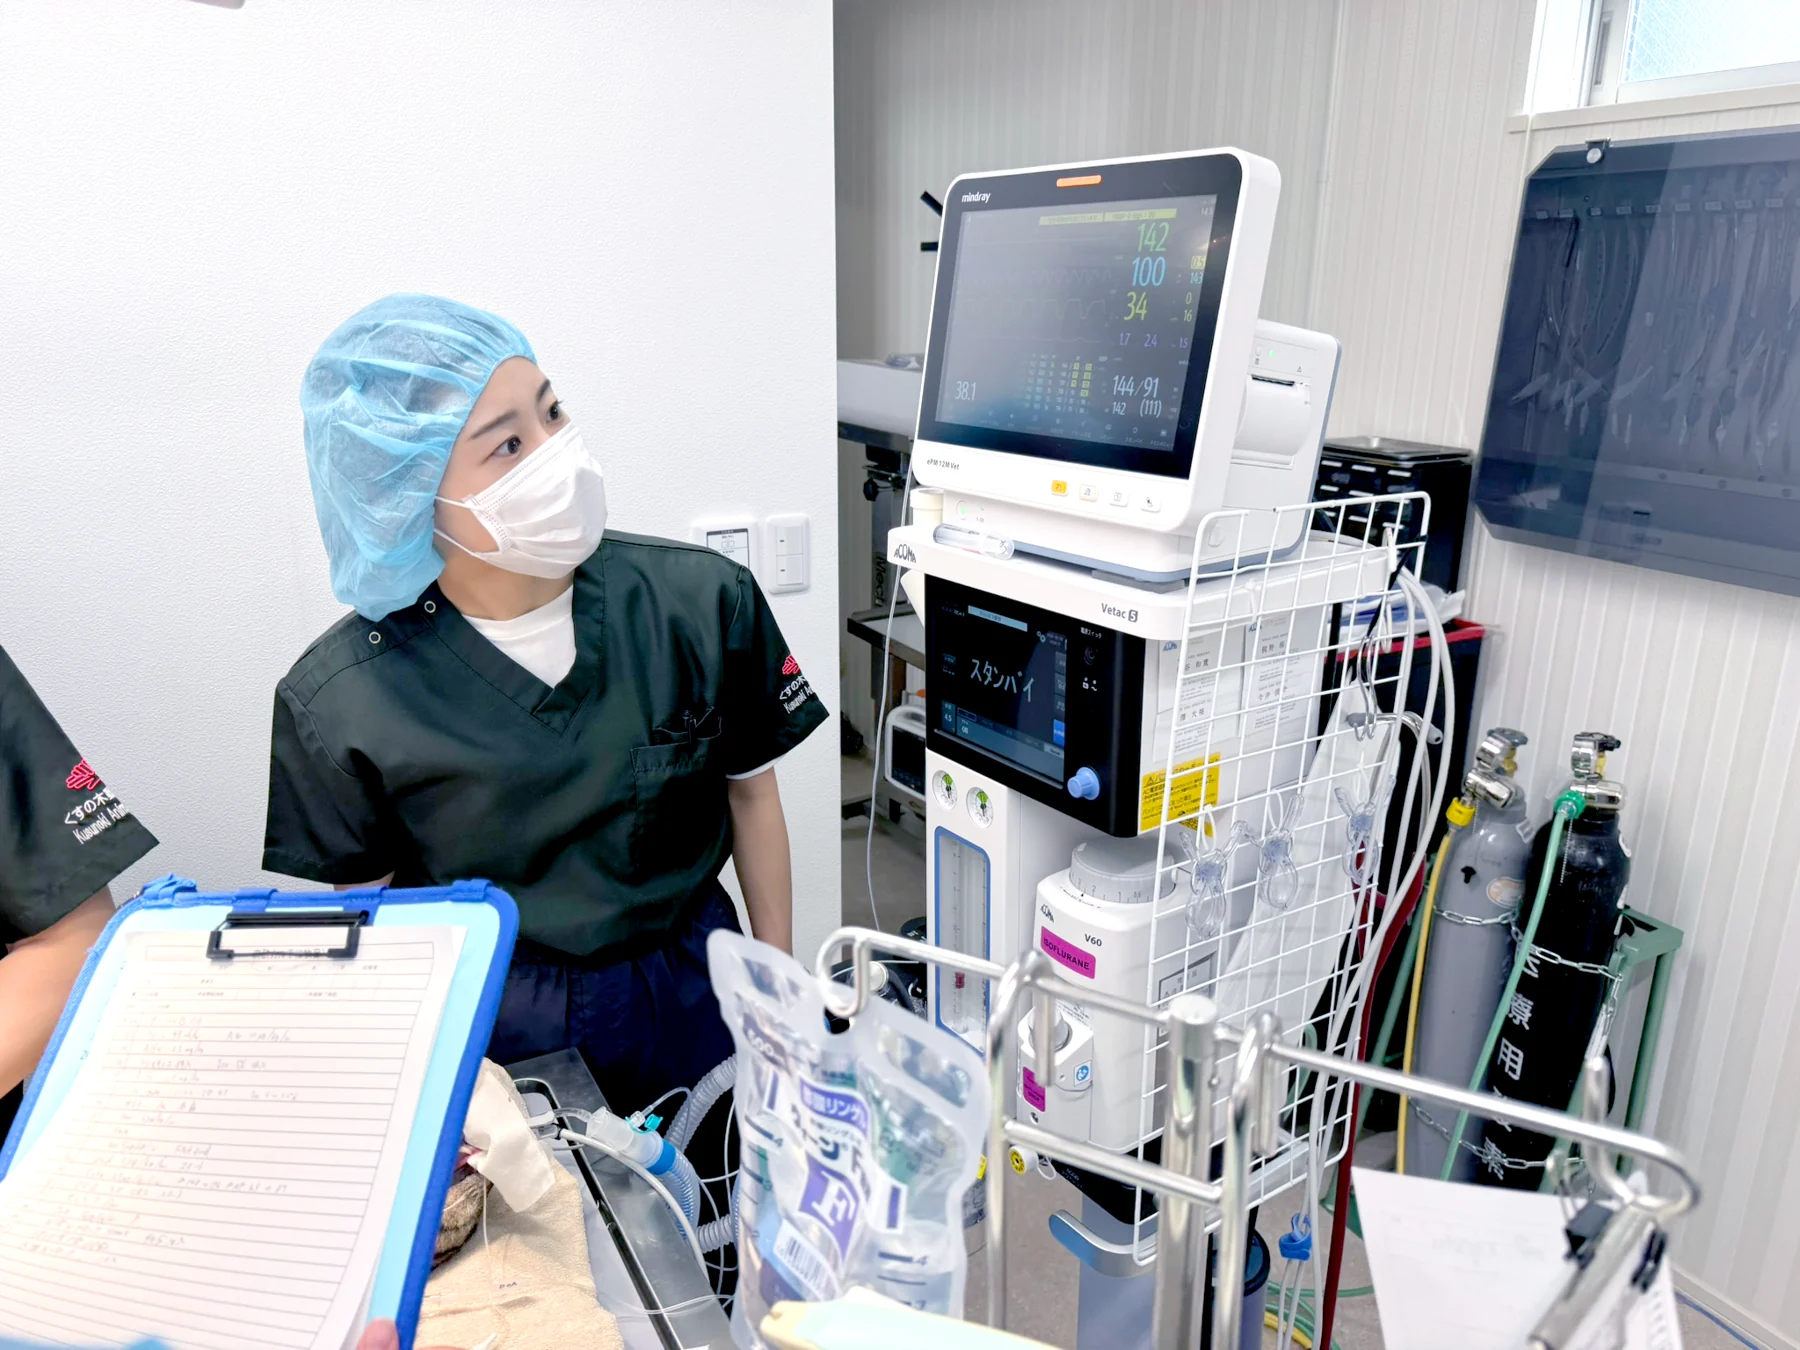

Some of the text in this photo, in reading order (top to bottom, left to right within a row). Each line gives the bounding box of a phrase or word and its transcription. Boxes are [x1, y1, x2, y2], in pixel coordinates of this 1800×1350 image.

[961, 192, 991, 203] mindray
[1138, 222, 1170, 252] 142
[1132, 256, 1166, 287] 100
[1124, 292, 1148, 320] 34
[954, 381, 977, 401] 38.1
[1112, 402, 1127, 416] 142
[893, 543, 917, 564] ACOMA
[1101, 602, 1126, 619] Vetac
[970, 658, 1035, 703] スタンバイ
[73, 812, 112, 844] Kusunoki
[1084, 933, 1103, 947] V60
[1043, 938, 1090, 971] ISOFLURANE
